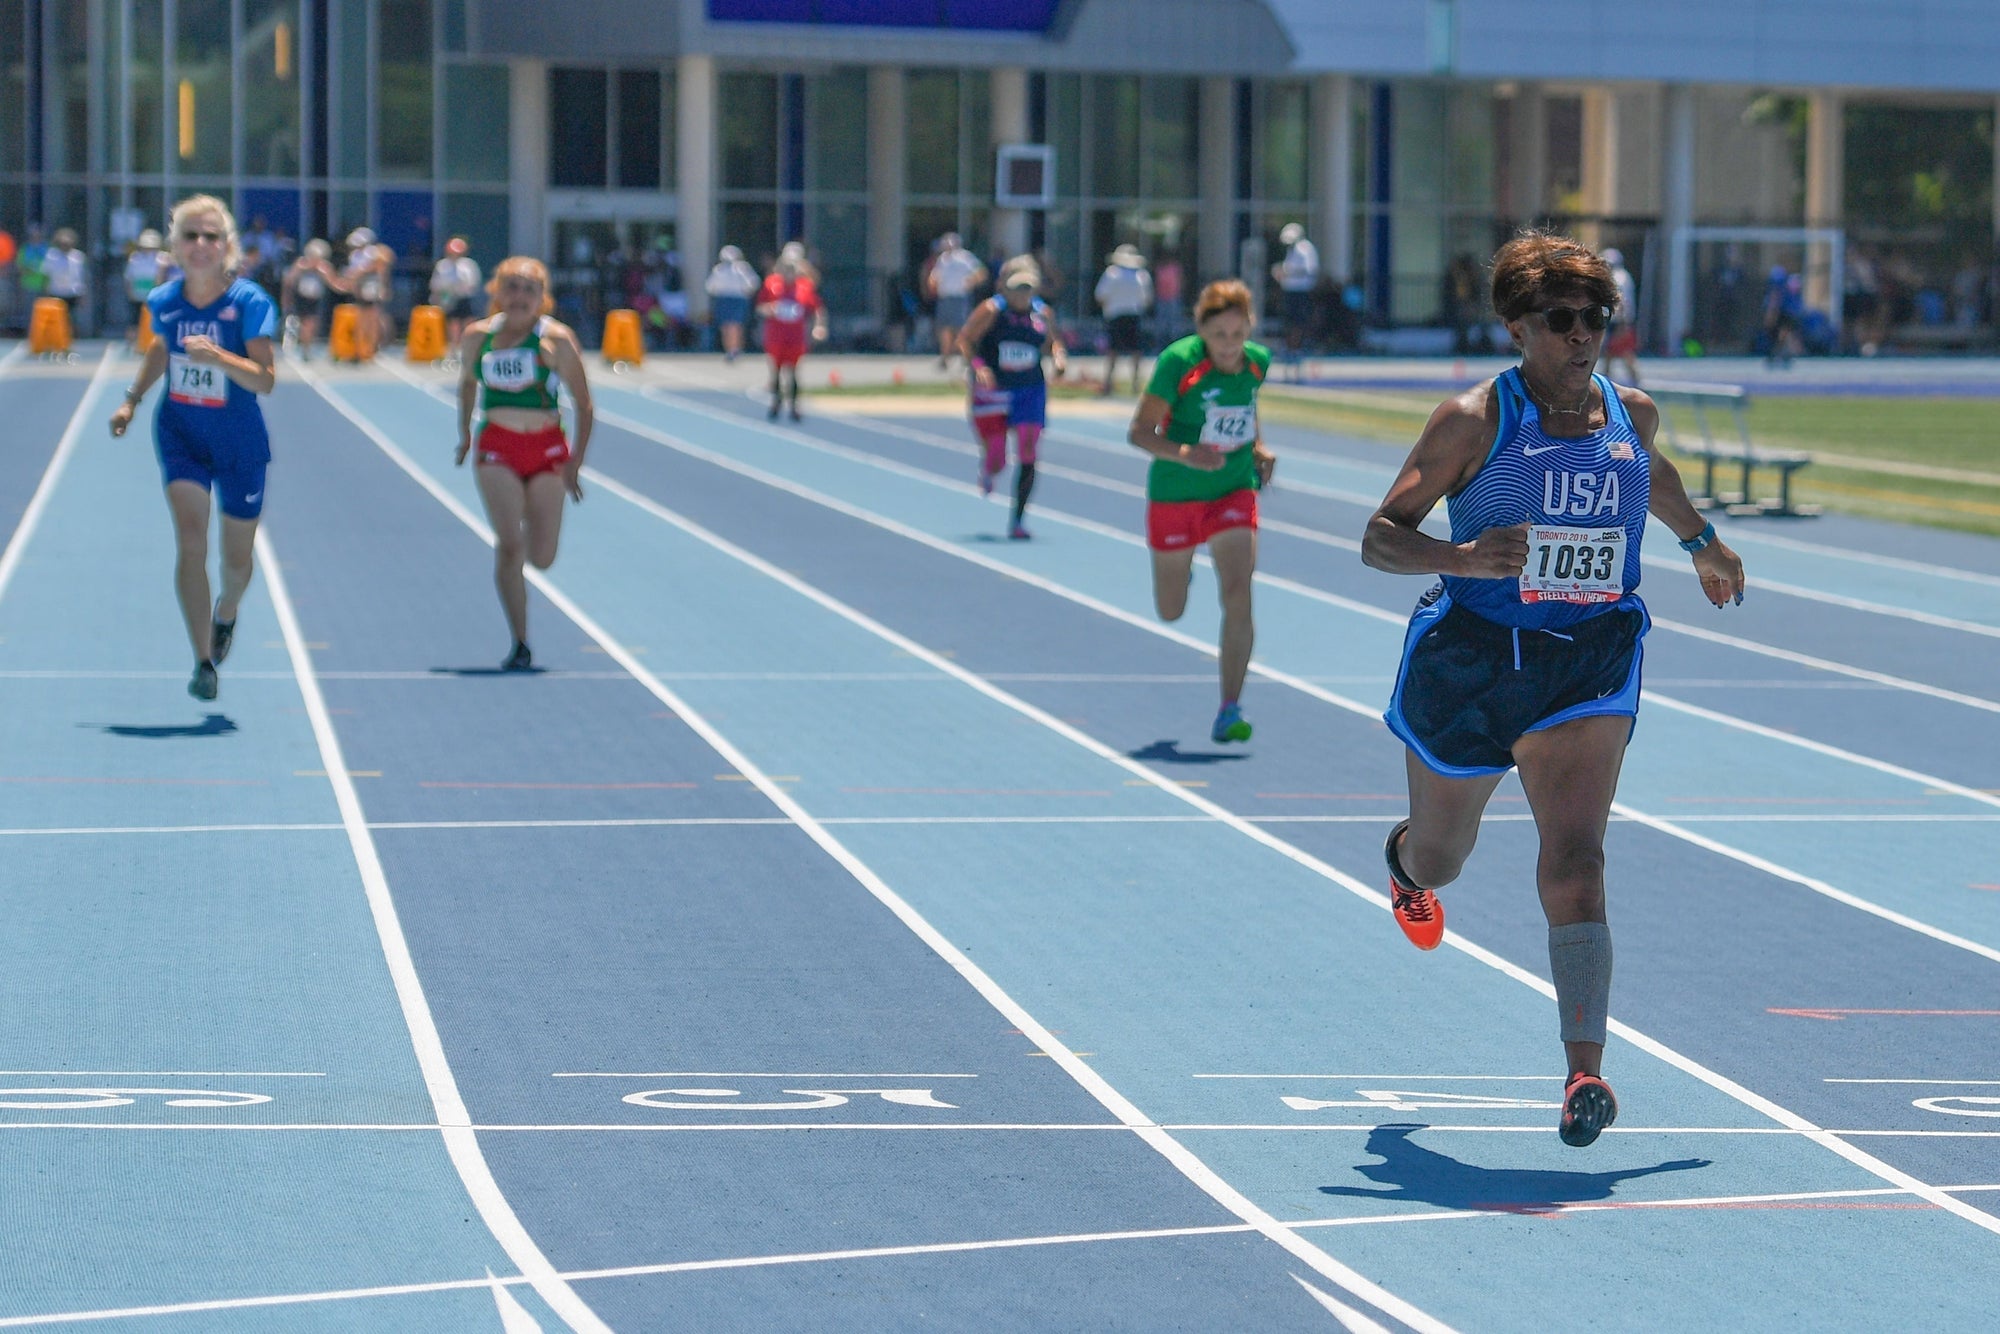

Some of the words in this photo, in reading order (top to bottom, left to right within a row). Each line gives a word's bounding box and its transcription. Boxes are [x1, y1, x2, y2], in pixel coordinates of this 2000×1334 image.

[177, 320, 219, 347] USA
[180, 367, 213, 388] 734
[1213, 416, 1246, 436] 422
[1543, 470, 1620, 516] USA
[1536, 531, 1567, 541] TORONTO
[1568, 532, 1588, 542] 2019
[1538, 544, 1615, 580] 1033
[1537, 592, 1567, 601] STEELE
[1568, 592, 1608, 603] MATTHEWS
[622, 1088, 960, 1110] 5
